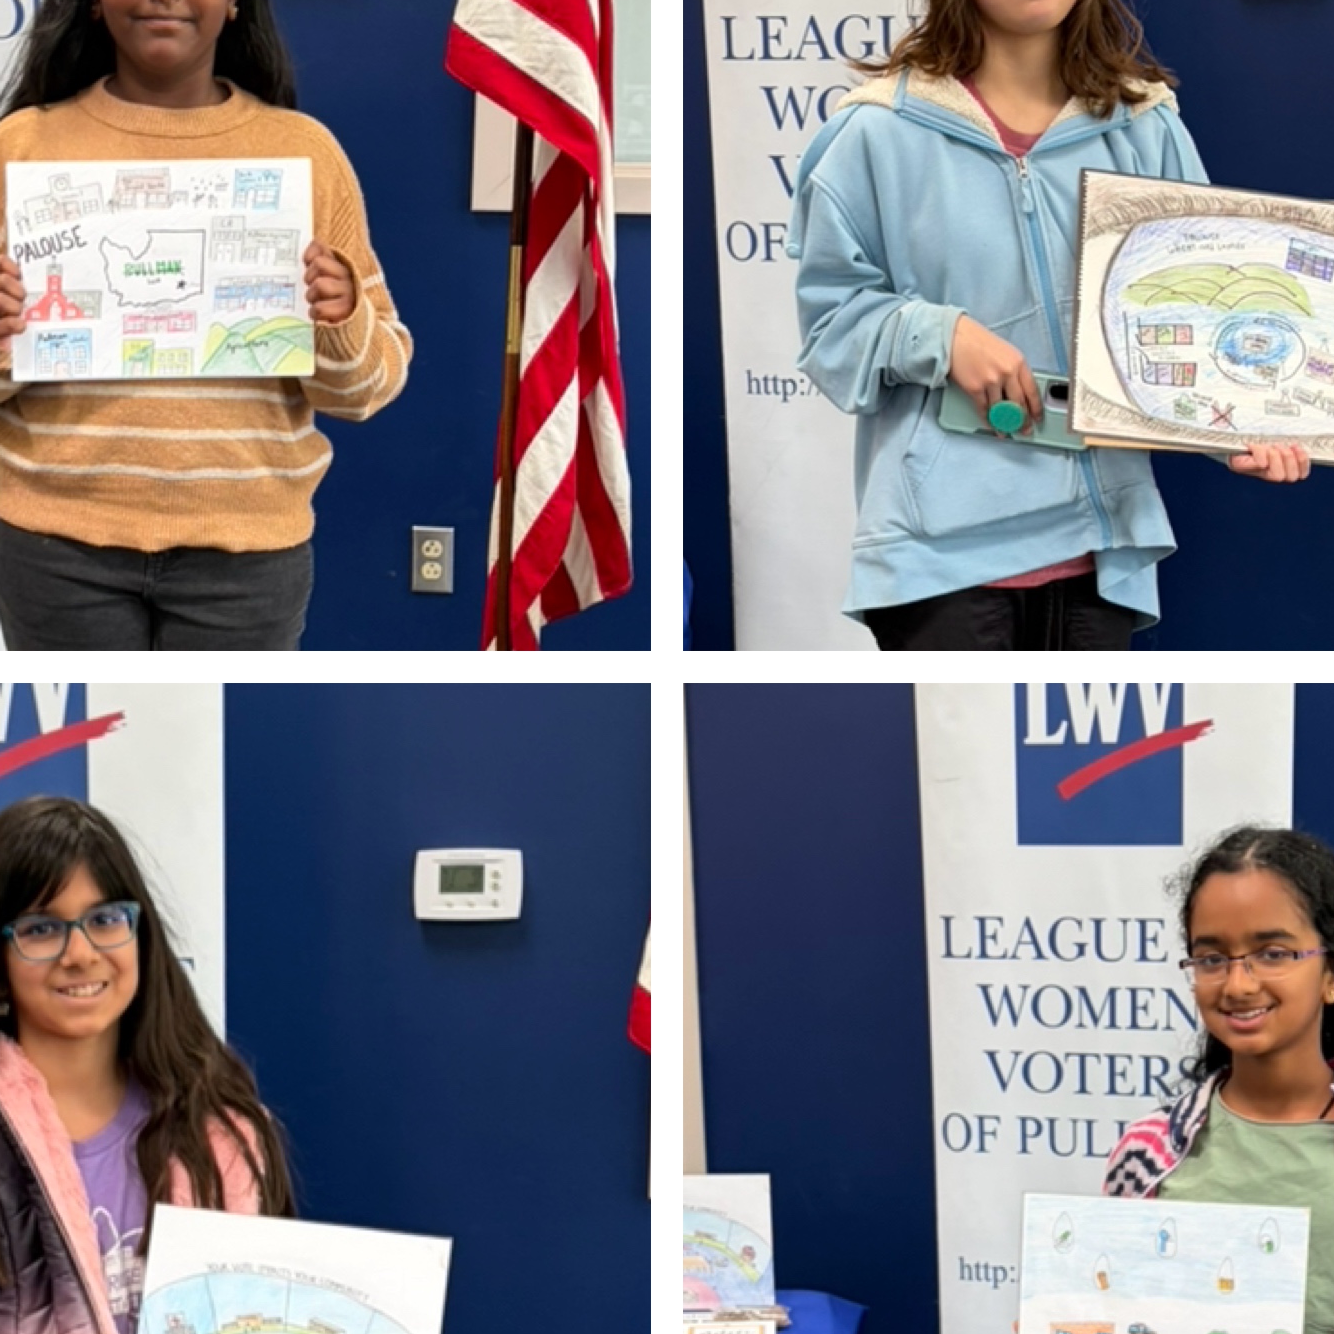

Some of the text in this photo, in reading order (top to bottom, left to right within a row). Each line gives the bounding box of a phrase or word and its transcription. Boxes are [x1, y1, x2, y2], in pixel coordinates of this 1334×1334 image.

[13, 225, 87, 264] PALOUSE
[726, 221, 788, 262] OF
[1024, 683, 1171, 744] LWV
[940, 916, 1168, 962] LEAGUE
[977, 984, 1199, 1031] WOMEN
[942, 1113, 1001, 1153] OF
